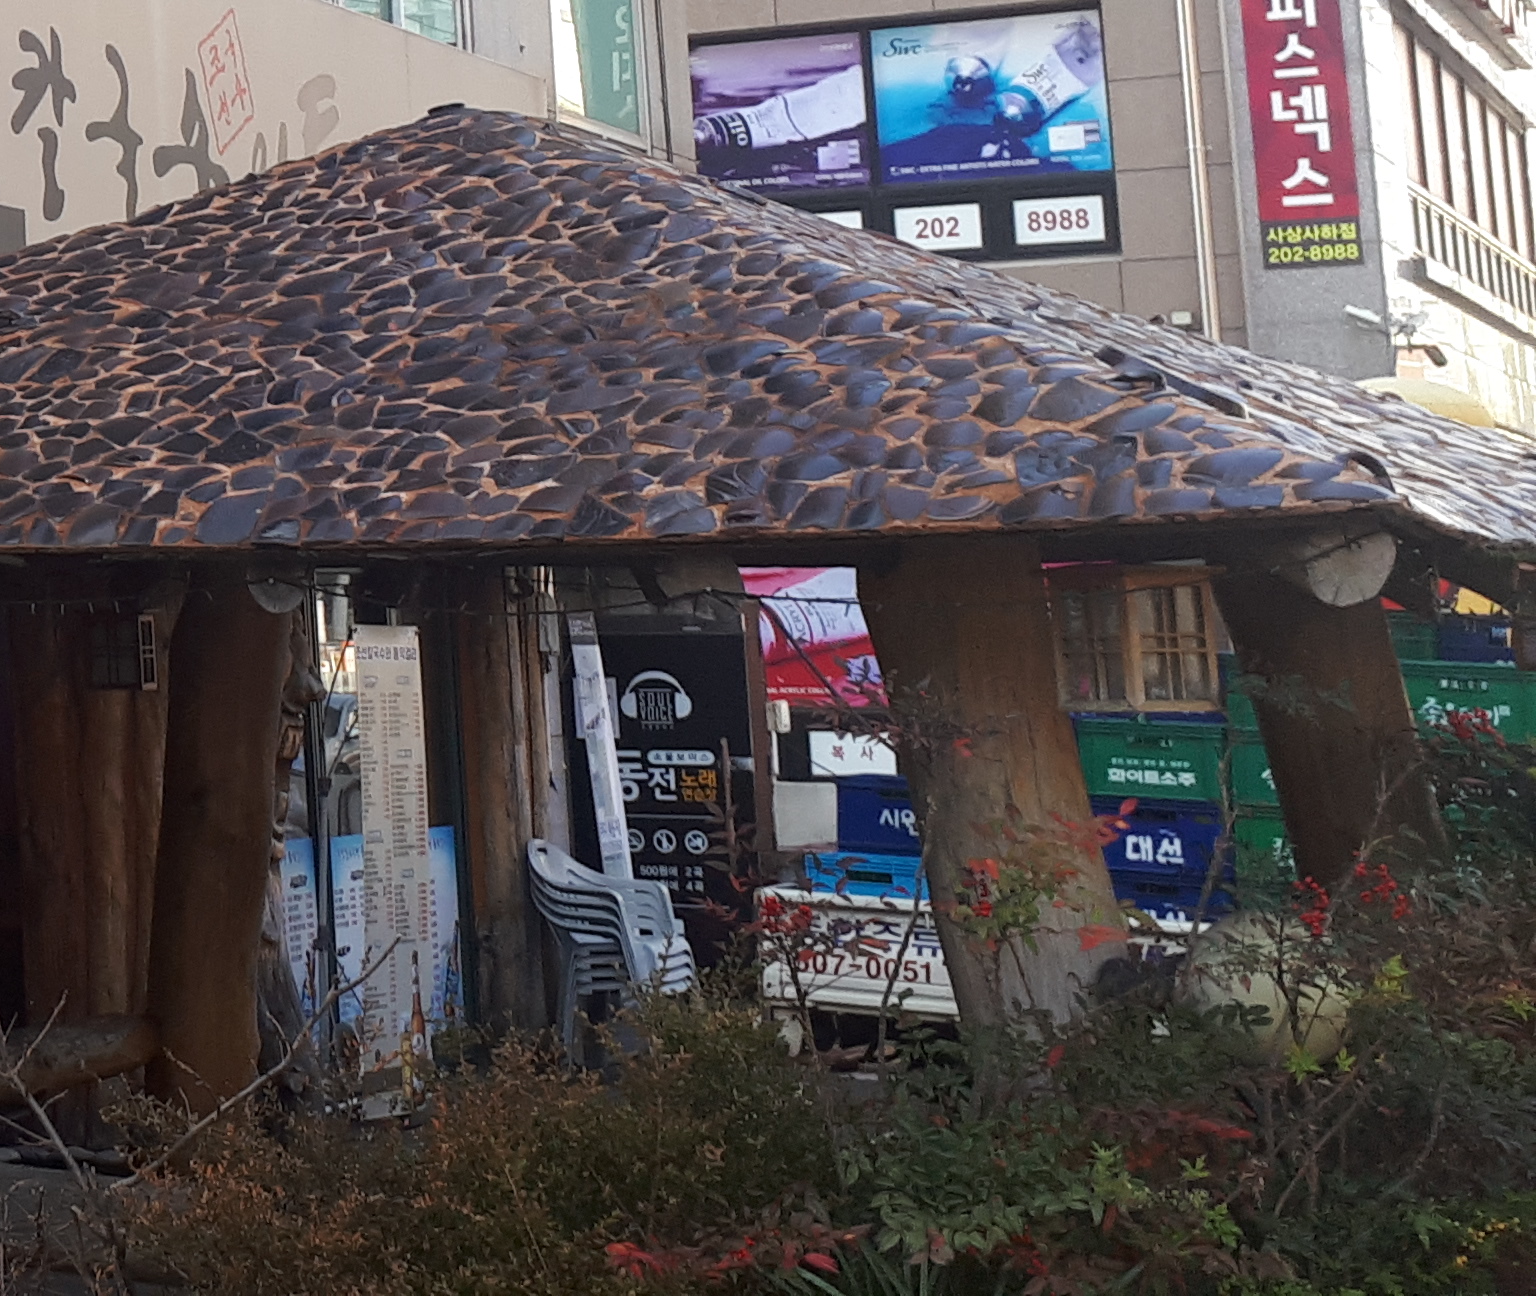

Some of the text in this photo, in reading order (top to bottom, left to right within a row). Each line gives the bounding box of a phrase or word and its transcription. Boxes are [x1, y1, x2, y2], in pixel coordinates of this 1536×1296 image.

[914, 208, 1091, 240] 202 8988
[1265, 221, 1358, 244] 사상사하점
[1268, 242, 1360, 264] 202-8988
[680, 769, 717, 788] 노래
[1107, 767, 1197, 787] 화이트소주
[1125, 832, 1185, 865] 대선
